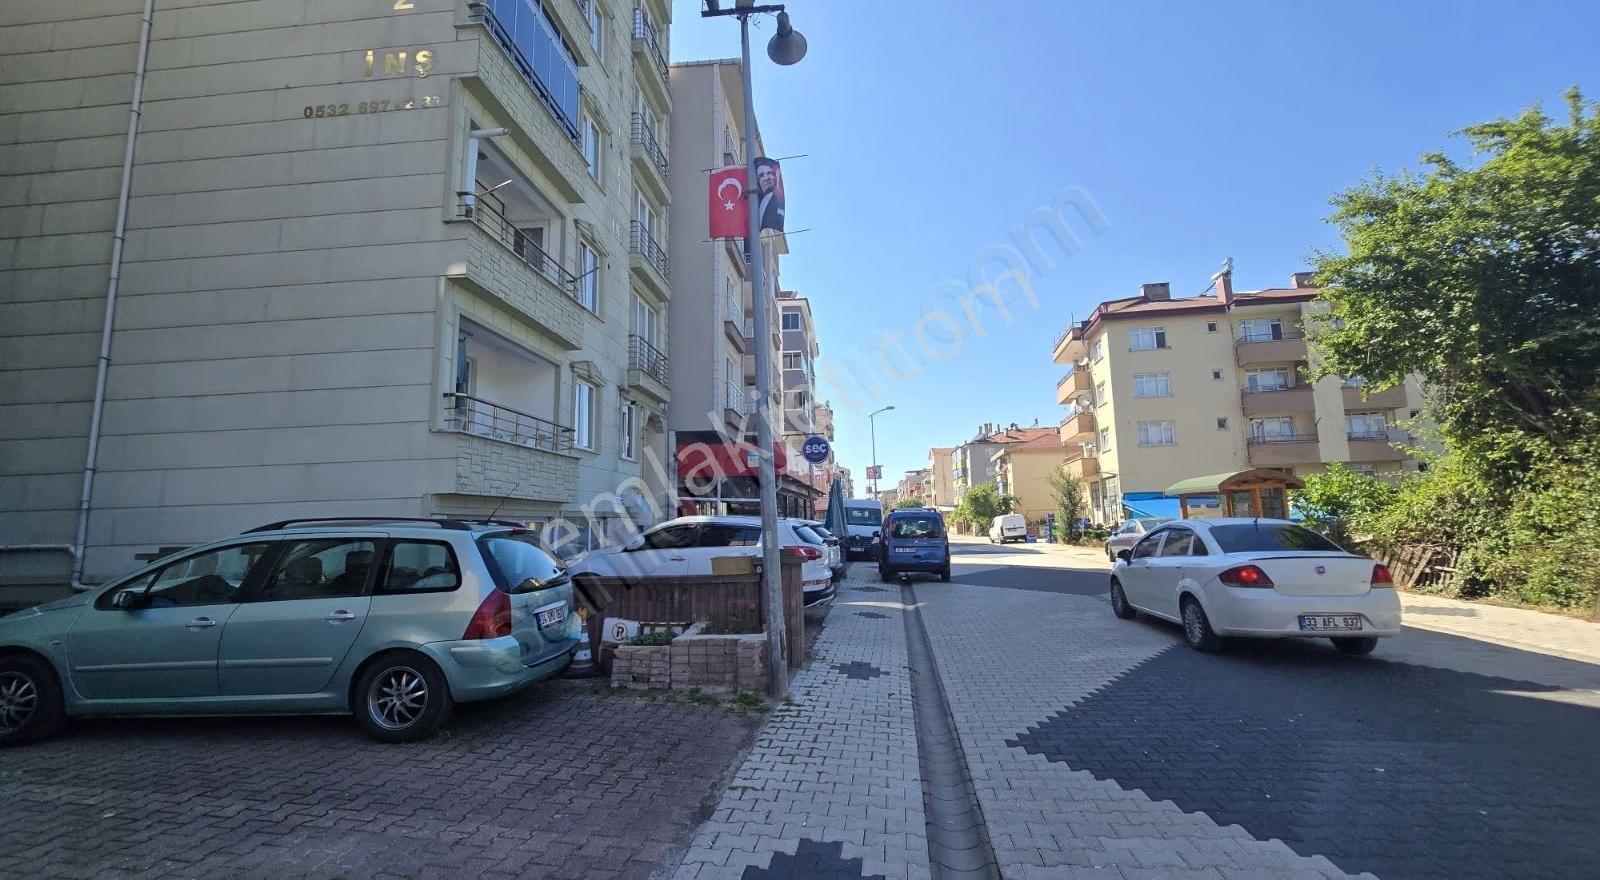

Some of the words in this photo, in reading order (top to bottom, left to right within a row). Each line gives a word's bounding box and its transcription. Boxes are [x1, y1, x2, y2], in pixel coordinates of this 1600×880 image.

[364, 50, 433, 77] İNŞ
[303, 104, 349, 119] 0532
[805, 443, 826, 454] sec
[1306, 617, 1318, 627] 33
[1322, 617, 1339, 627] AFL
[1343, 617, 1359, 627] 937
